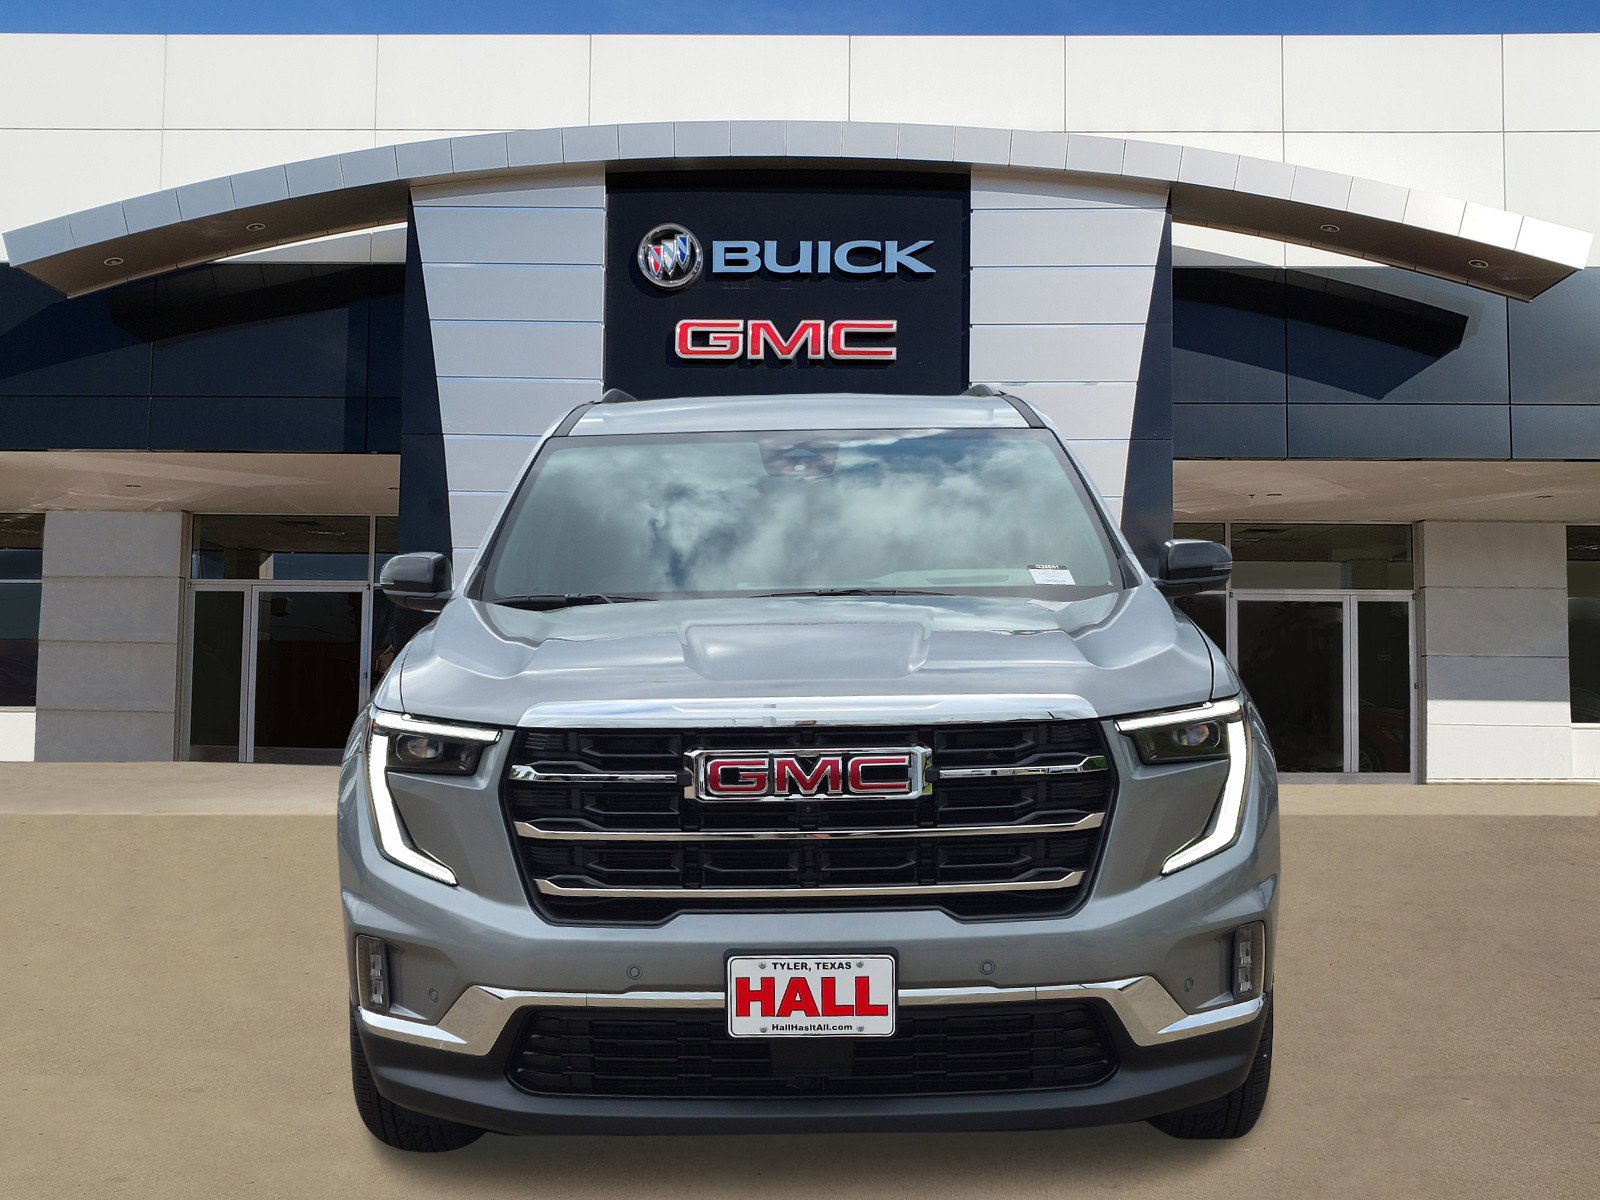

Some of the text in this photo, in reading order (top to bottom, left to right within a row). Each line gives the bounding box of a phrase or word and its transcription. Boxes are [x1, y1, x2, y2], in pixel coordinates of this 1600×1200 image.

[712, 240, 936, 274] BUICK
[675, 319, 898, 360] GMC
[707, 755, 911, 795] GMC
[771, 961, 852, 972] TYLER, TEXAS
[735, 976, 889, 1017] HALL
[771, 1023, 853, 1032] HallHasItAll.com
